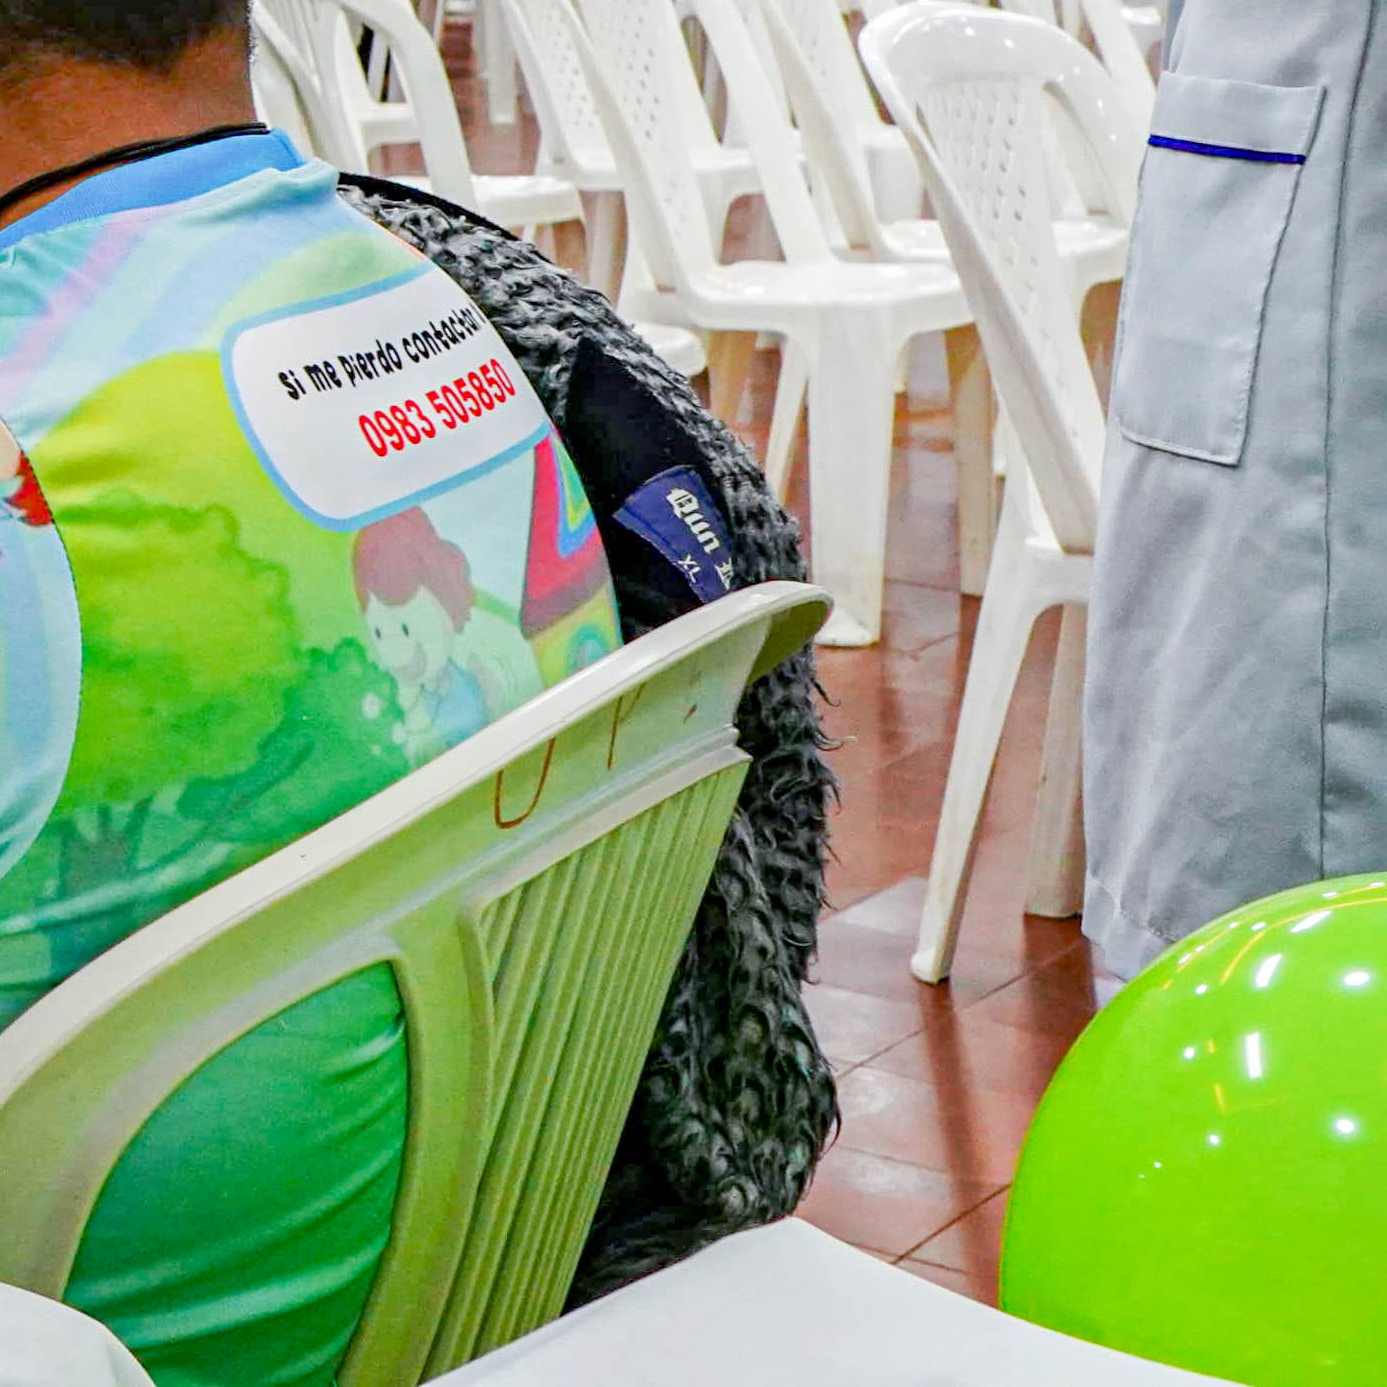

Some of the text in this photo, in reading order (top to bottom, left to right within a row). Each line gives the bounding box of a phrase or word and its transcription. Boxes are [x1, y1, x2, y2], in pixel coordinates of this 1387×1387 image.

[303, 361, 342, 392] me
[337, 340, 403, 387] pierdo
[358, 358, 516, 457] 0983 505850
[678, 554, 700, 583] XL
